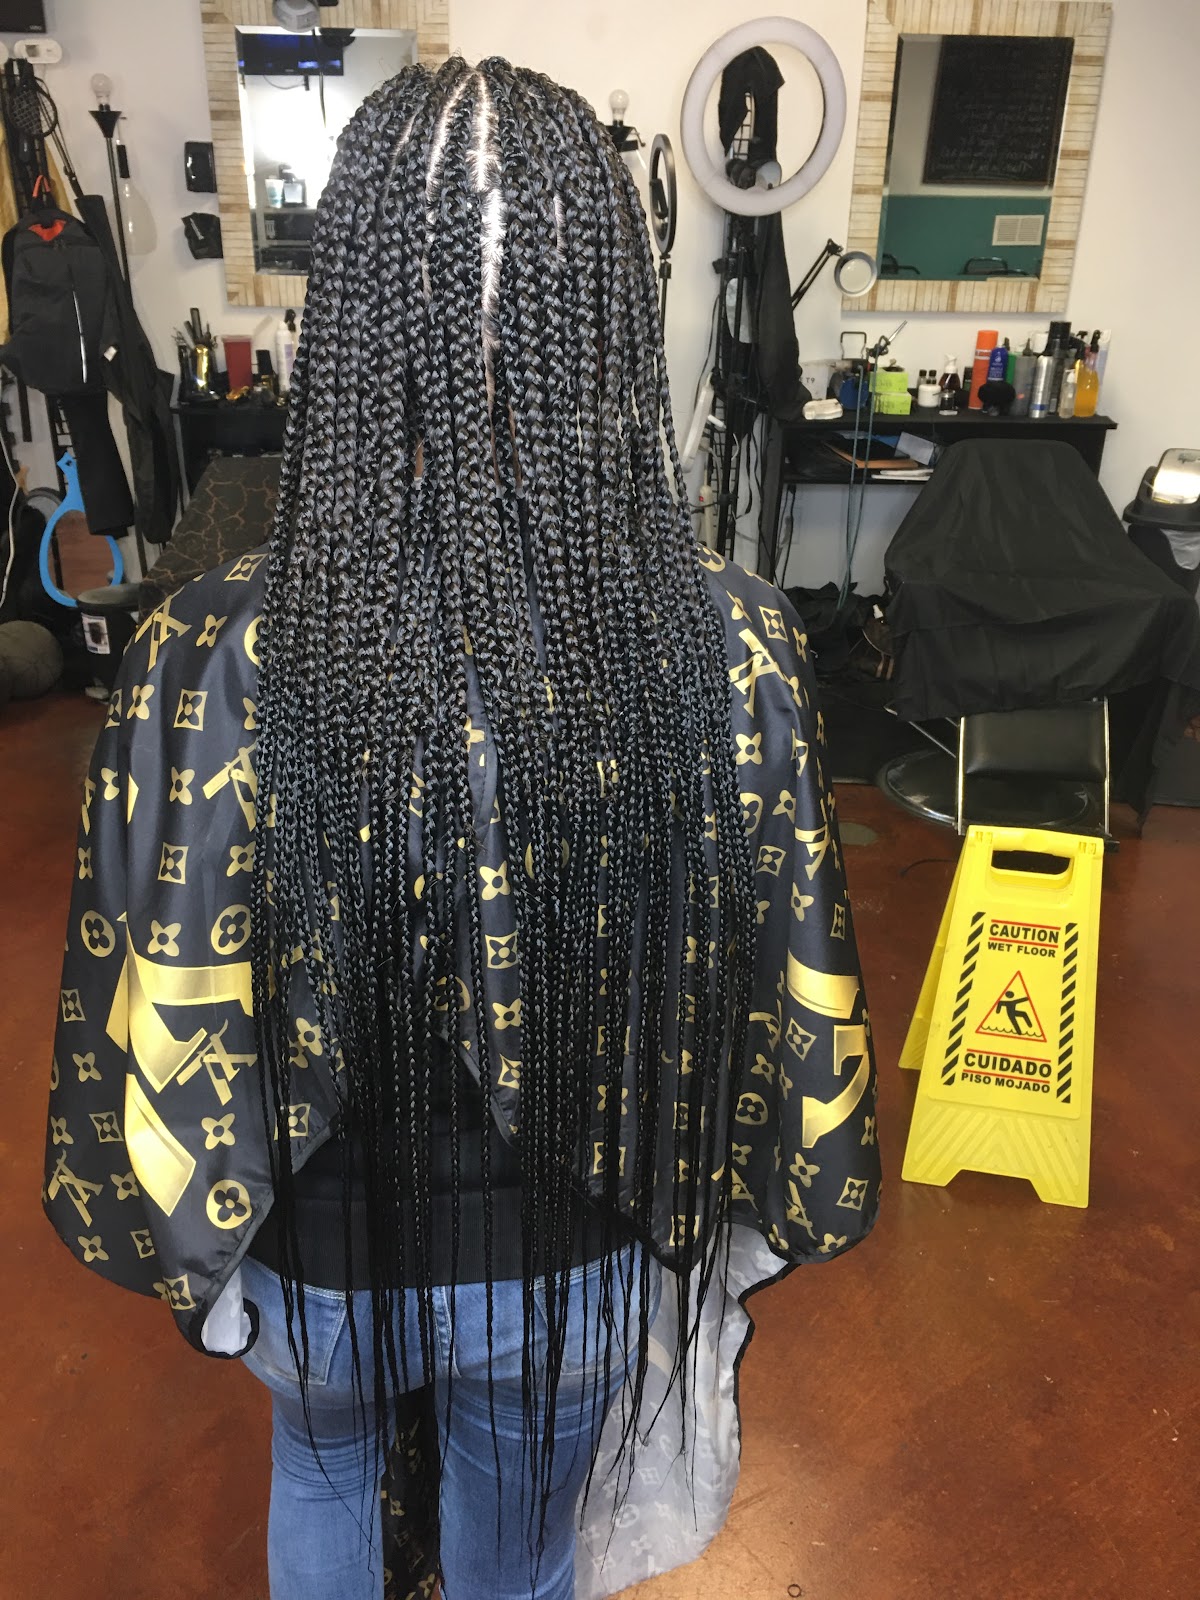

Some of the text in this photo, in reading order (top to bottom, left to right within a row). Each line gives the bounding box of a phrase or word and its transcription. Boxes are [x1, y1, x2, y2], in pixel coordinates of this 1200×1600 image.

[989, 923, 1060, 944] CAUTION
[988, 941, 1057, 958] WET FLOOR
[964, 1052, 1053, 1078] CUIDADO
[961, 1072, 1051, 1094] PISO MOJADO
